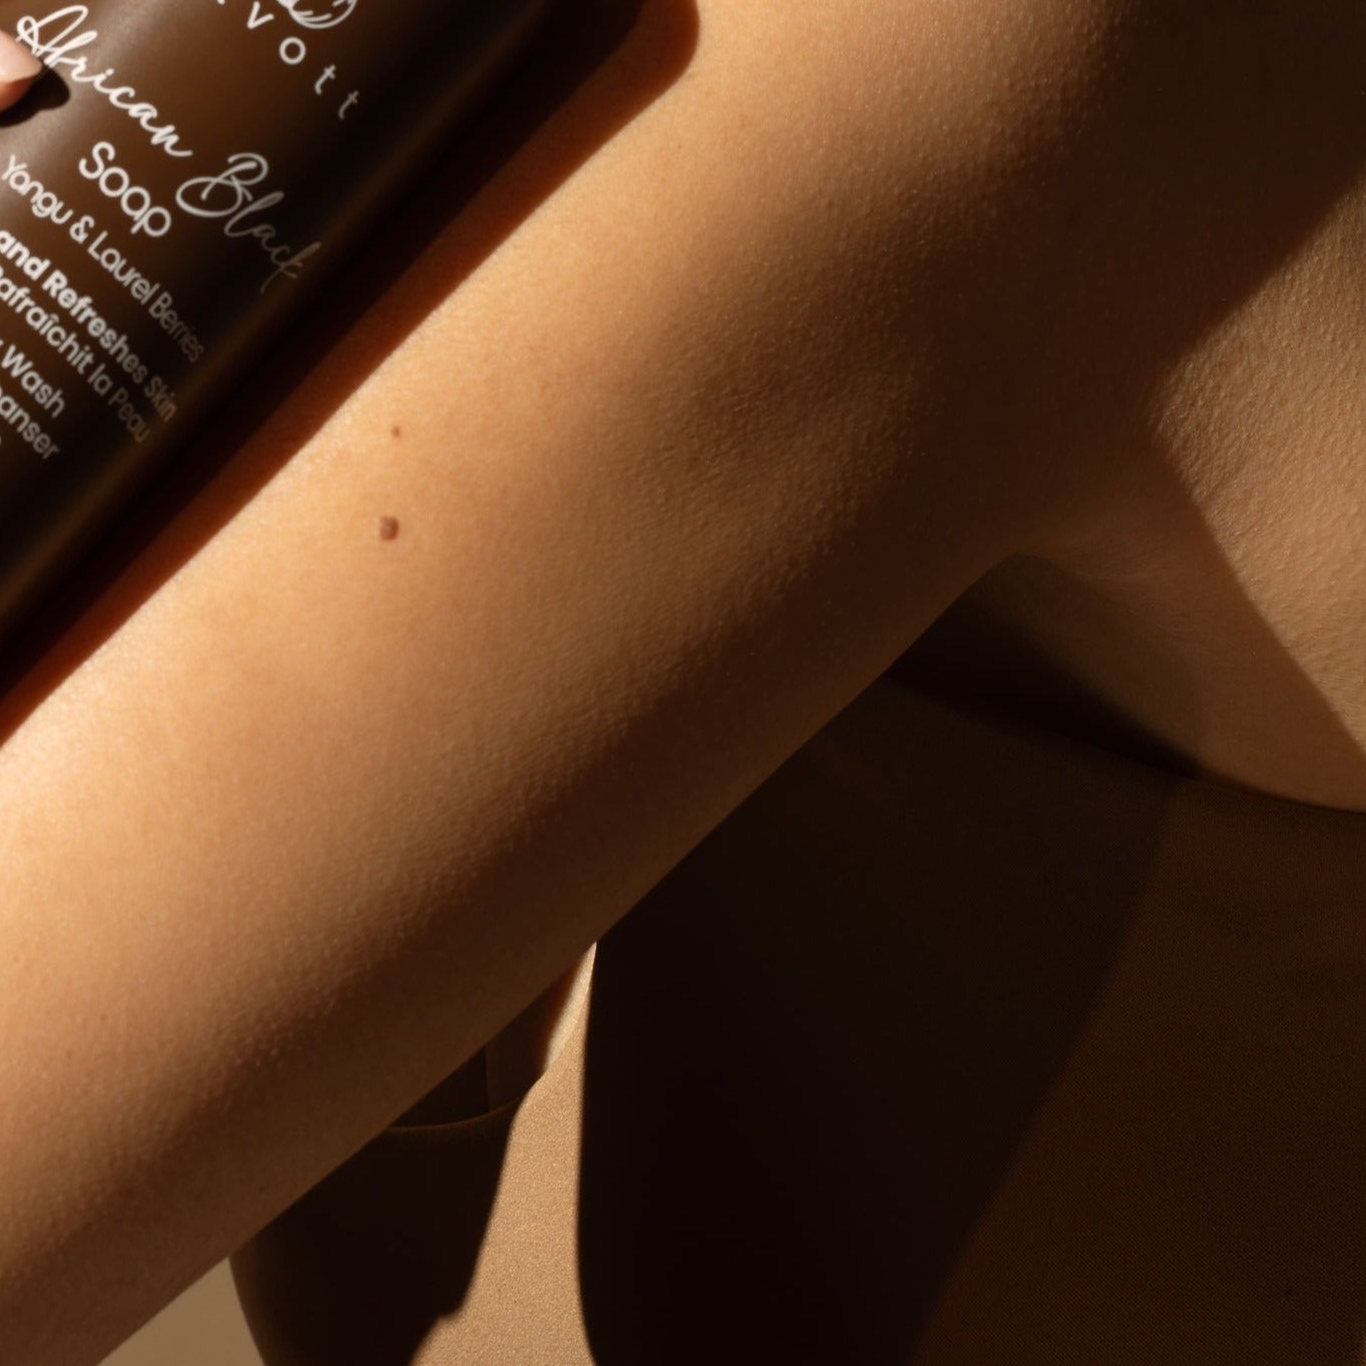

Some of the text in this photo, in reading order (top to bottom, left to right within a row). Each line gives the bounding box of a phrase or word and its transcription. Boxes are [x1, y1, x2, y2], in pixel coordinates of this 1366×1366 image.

[15, 4, 322, 294] African Black
[78, 141, 172, 237] Soap
[1, 153, 74, 225] Yangu
[69, 215, 95, 244] &
[87, 230, 161, 306] Laurel
[148, 290, 205, 363] Berries
[0, 344, 65, 419] Wash
[41, 268, 149, 384] Refreshes
[143, 374, 177, 423] Skin
[86, 362, 114, 397] la
[106, 386, 151, 443] Peau
